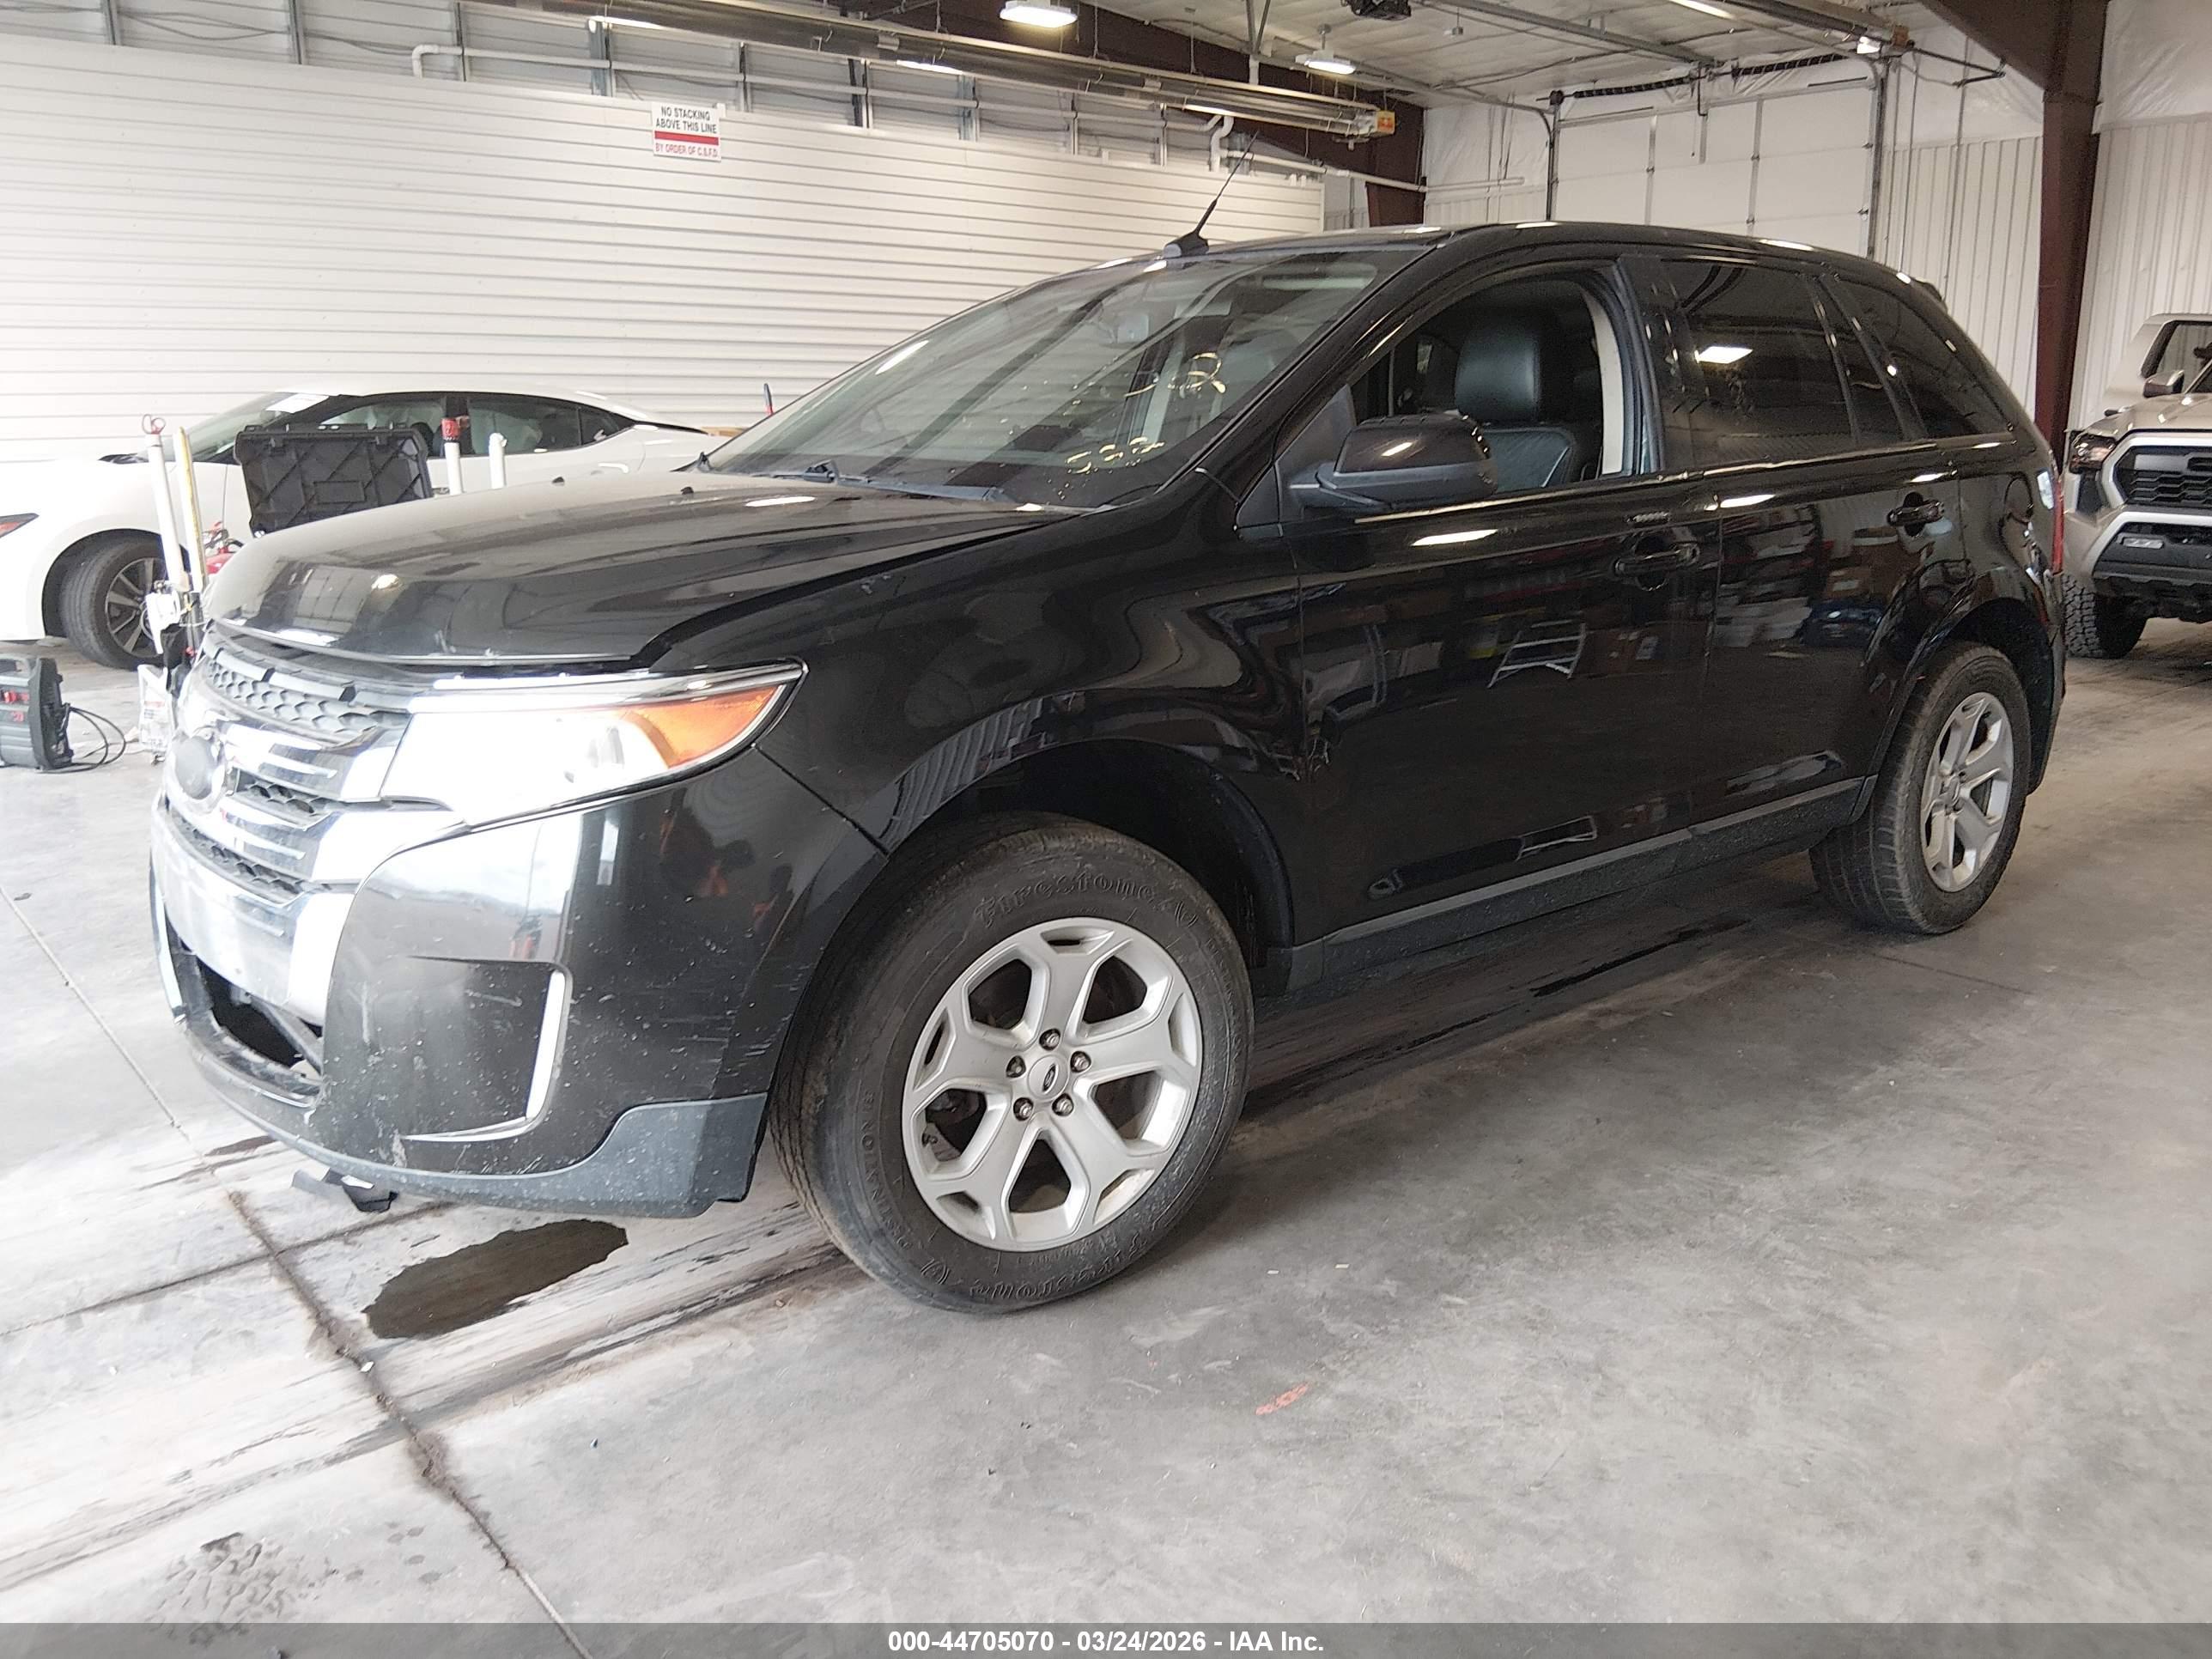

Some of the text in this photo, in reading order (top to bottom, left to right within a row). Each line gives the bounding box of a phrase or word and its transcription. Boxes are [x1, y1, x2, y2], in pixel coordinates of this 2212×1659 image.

[660, 106, 711, 121] NO STACKING
[655, 118, 717, 134] ABOVE THIS LINE
[655, 143, 664, 152] BY
[665, 143, 686, 155] ORDER
[688, 146, 696, 155] OF
